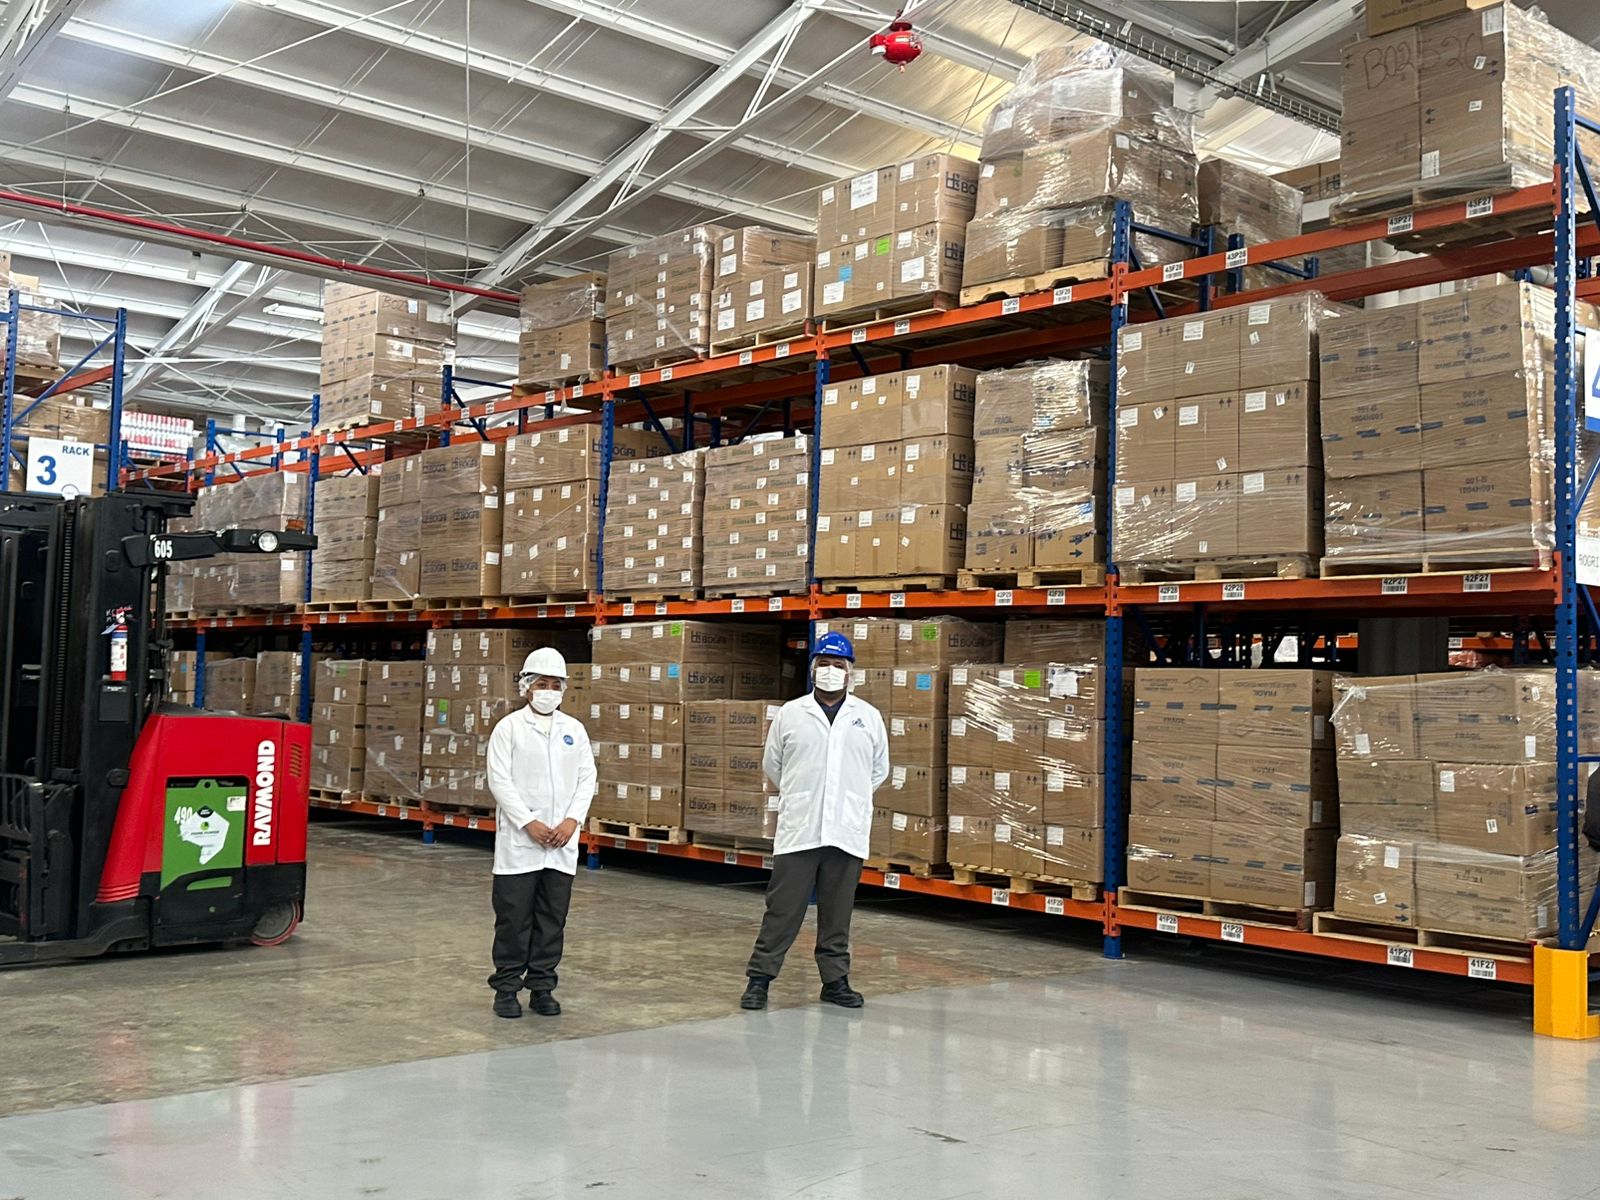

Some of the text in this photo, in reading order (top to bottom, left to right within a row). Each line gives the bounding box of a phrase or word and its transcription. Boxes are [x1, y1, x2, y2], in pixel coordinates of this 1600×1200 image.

[1389, 214, 1412, 226] 43P27
[62, 445, 90, 456] RACK
[36, 455, 57, 486] 3
[154, 540, 173, 559] 605
[1384, 577, 1406, 586] 42P27
[1465, 574, 1489, 583] 42F27
[1224, 584, 1243, 592] 42P28
[253, 740, 276, 846] RAYMOND
[1389, 946, 1413, 958] 41P27
[1471, 958, 1495, 970] 41F27
